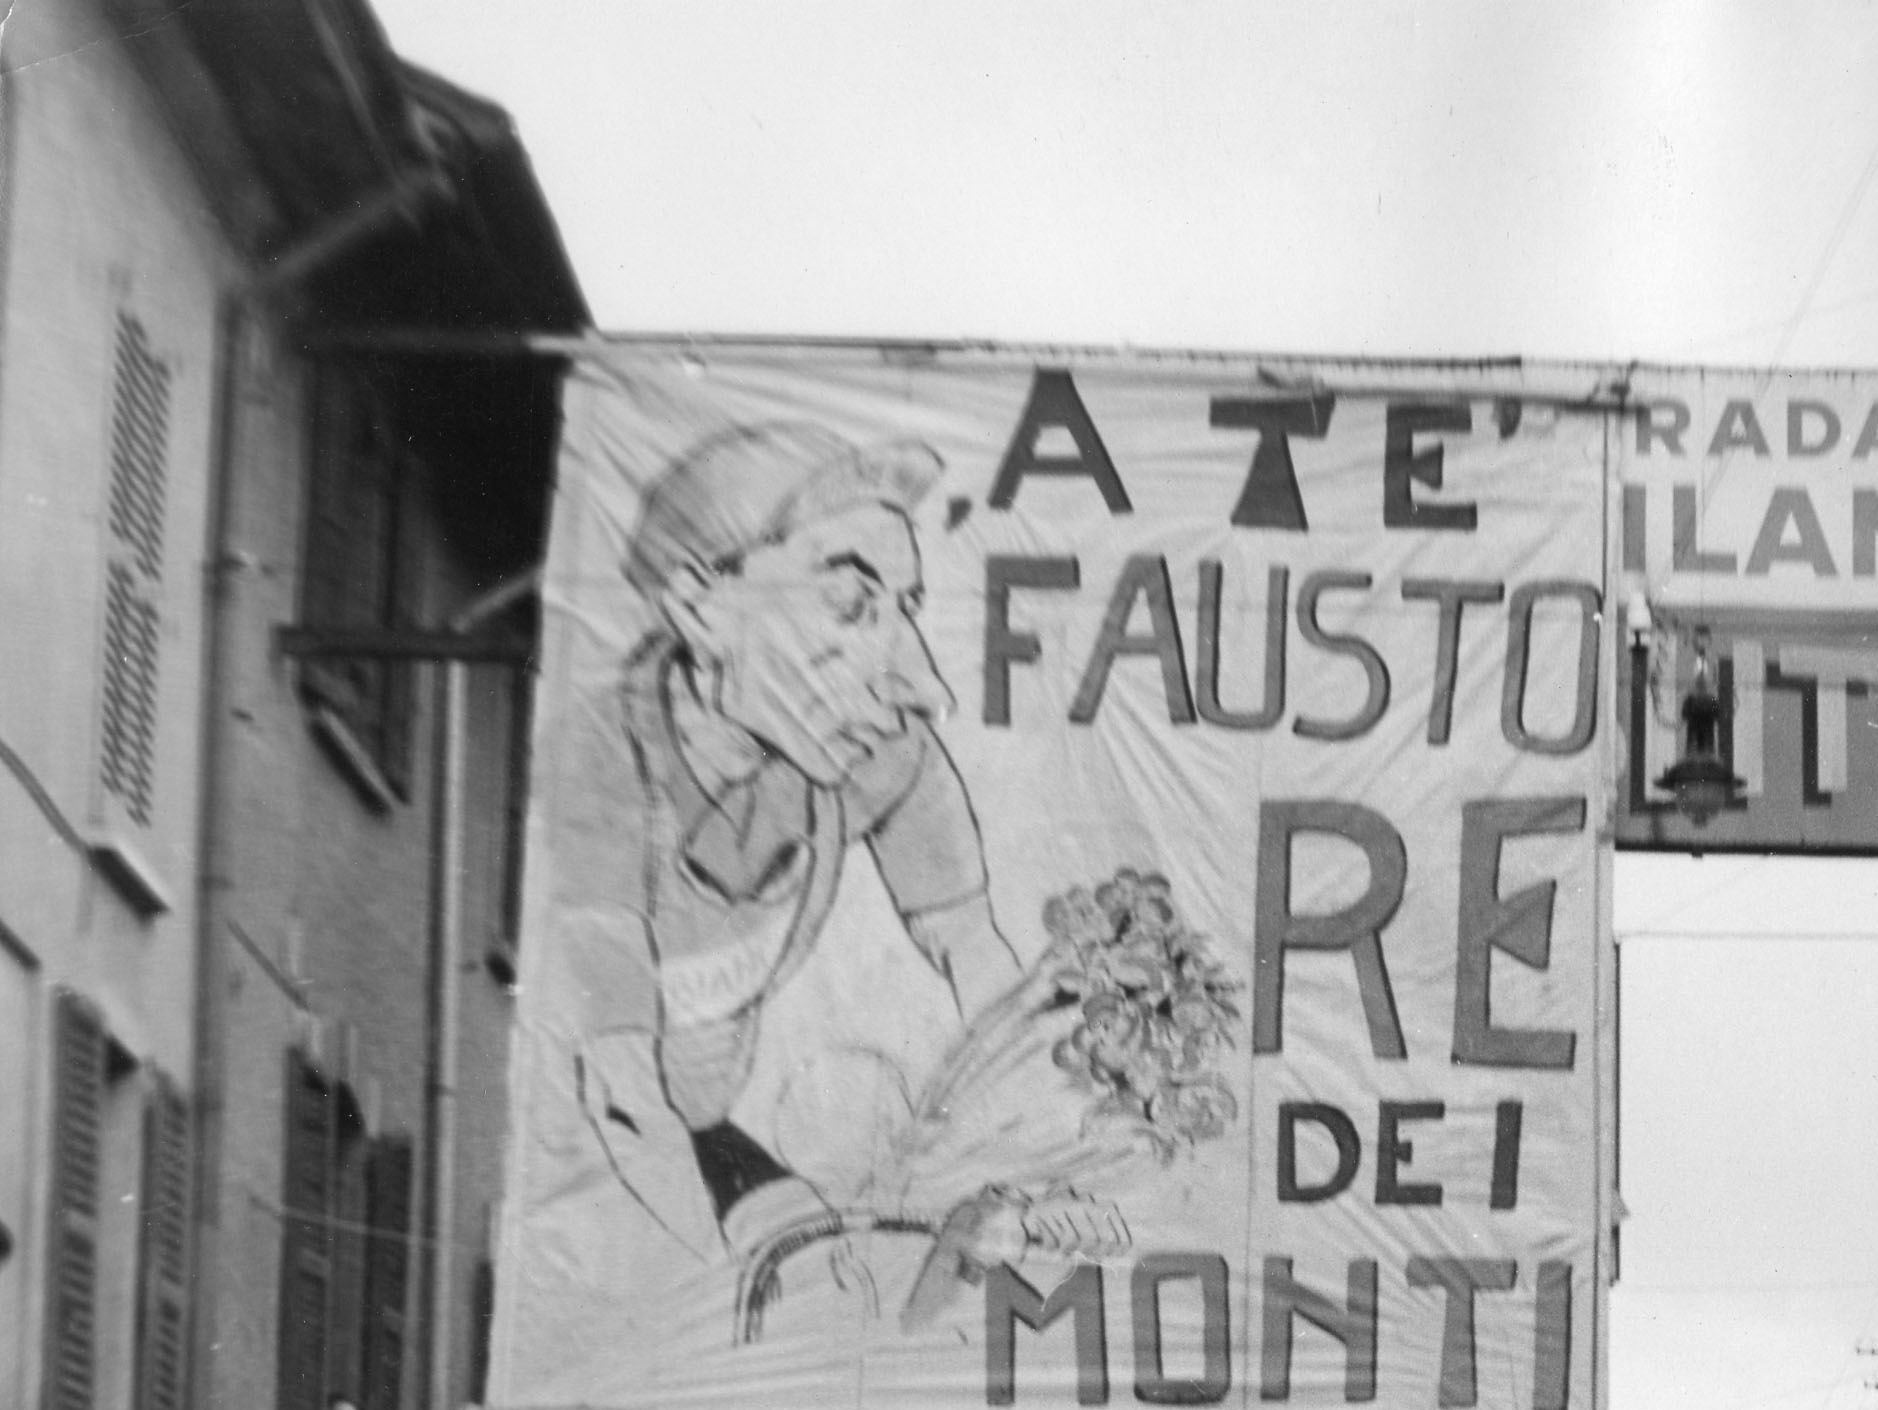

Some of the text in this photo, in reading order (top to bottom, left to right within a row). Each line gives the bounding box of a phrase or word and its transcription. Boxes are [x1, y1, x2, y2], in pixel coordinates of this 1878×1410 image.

[988, 368, 1133, 513] A
[982, 551, 1602, 757] FAUSTO
[1253, 799, 1588, 1071] RE
[1277, 1100, 1522, 1209] DEI
